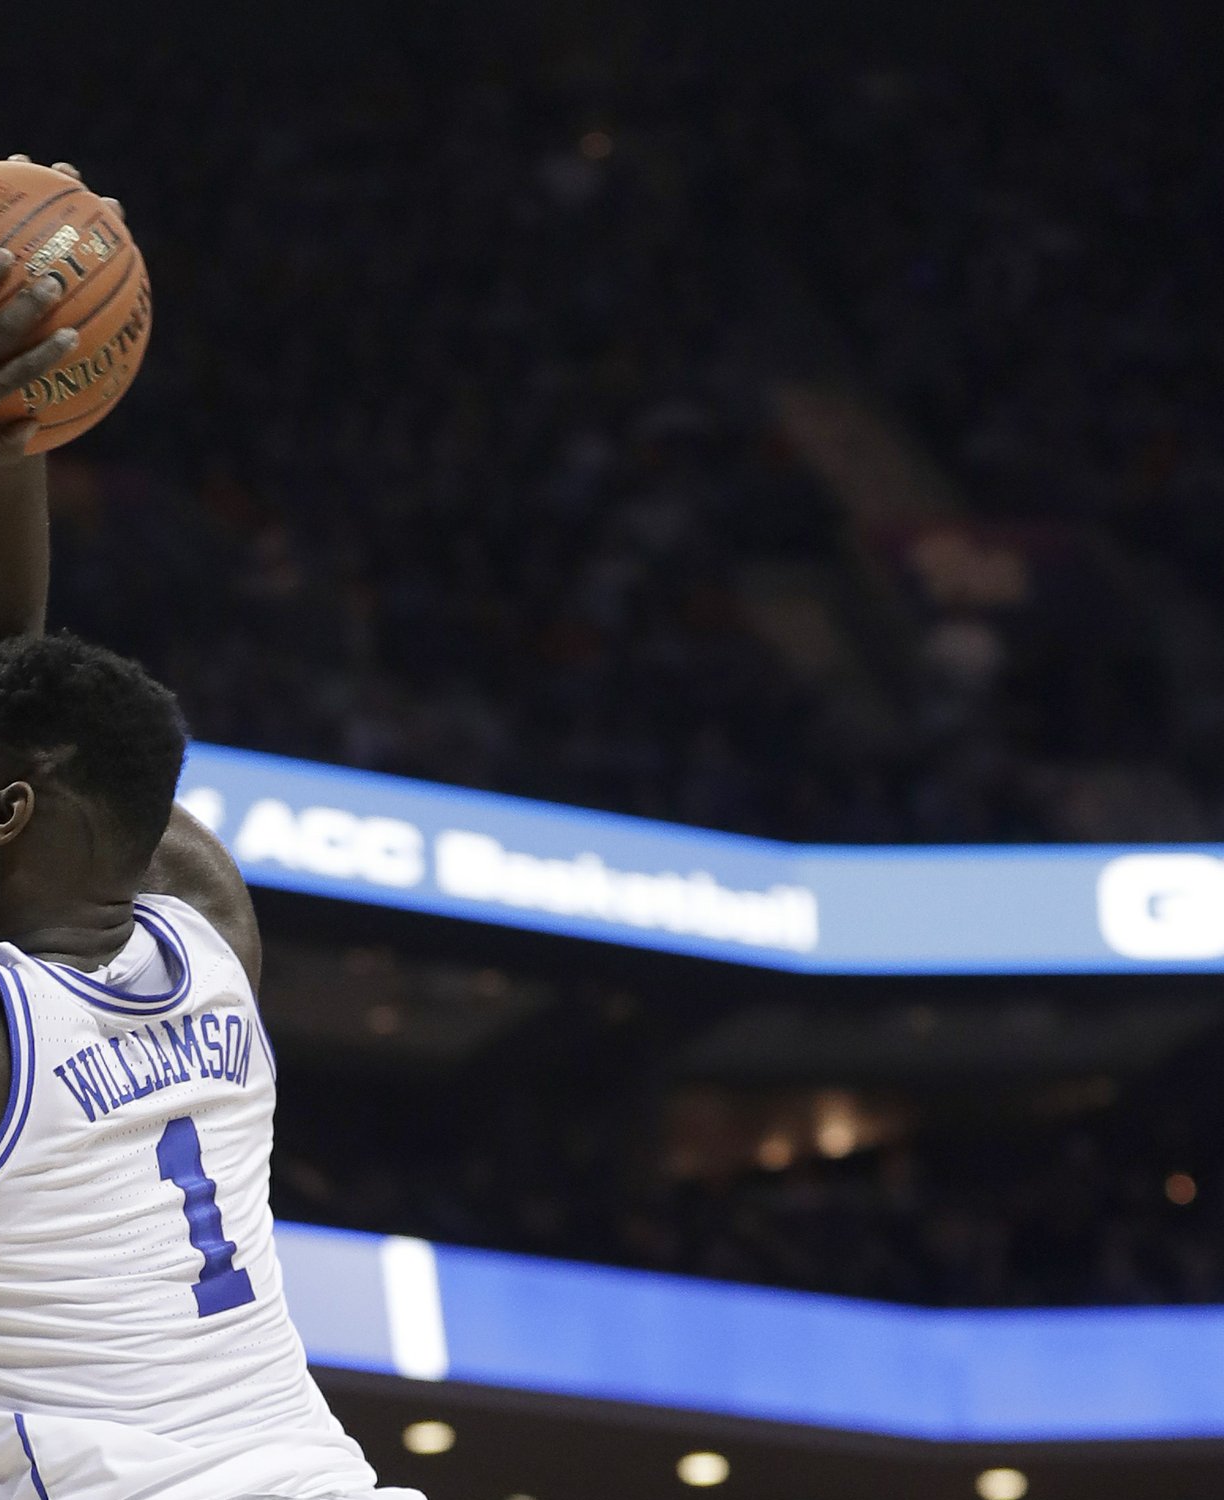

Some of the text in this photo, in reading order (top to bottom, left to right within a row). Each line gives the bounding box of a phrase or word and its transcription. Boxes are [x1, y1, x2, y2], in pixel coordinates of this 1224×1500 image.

[236, 800, 424, 888] ACC
[435, 829, 818, 954] Basketball
[53, 1014, 252, 1122] WILLIAMSON
[156, 1116, 256, 1317] 1
